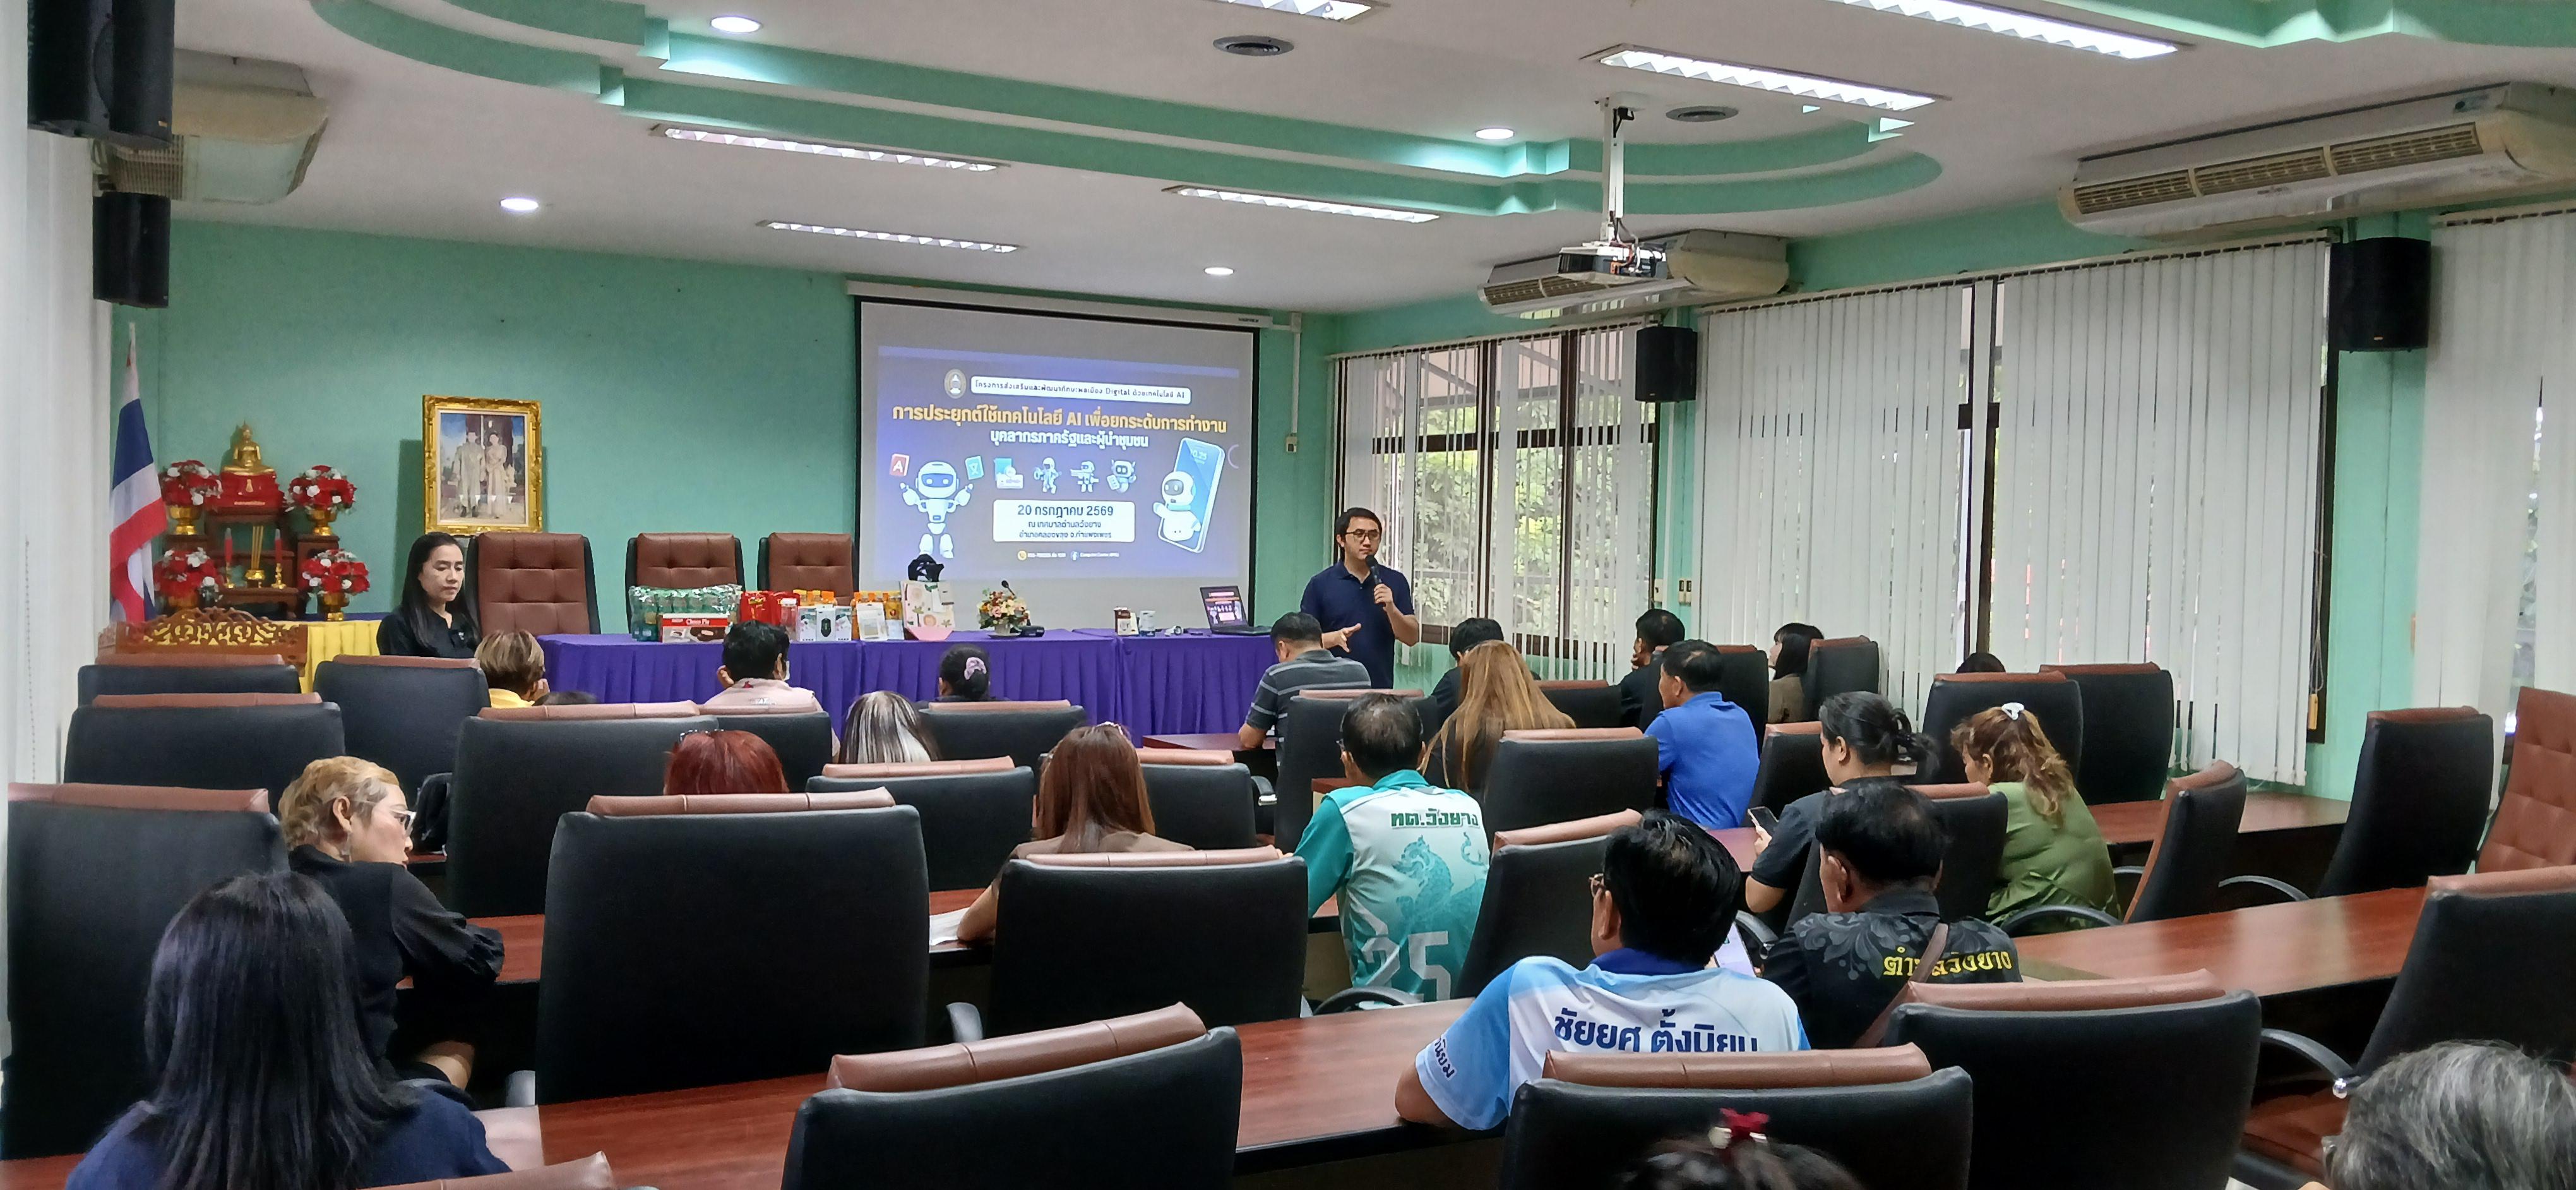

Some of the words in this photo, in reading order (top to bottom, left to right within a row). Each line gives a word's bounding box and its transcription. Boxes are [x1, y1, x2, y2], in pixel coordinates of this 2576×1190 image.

[1106, 387, 1130, 397] Digital
[892, 404, 1063, 426] การประยุกต์ใช้เทคโนโลยี
[1066, 411, 1082, 426] AI
[1085, 406, 1227, 433] เพื่อยกระดับการทำงาน
[990, 429, 1149, 450] บุคลากรภาครัฐและผู้นำชุมชน
[893, 460, 903, 473] A
[1017, 505, 1032, 515] 20
[1035, 506, 1083, 519] กรกฎาคม
[1087, 506, 1114, 516] 2569
[1390, 808, 1479, 827] ทต.วังยาง
[1359, 931, 1452, 1002] 25
[1883, 946, 2012, 977] ตำลวังยาง
[1554, 1007, 1642, 1052] ชัยยศ
[1434, 1037, 1455, 1078] านิยม
